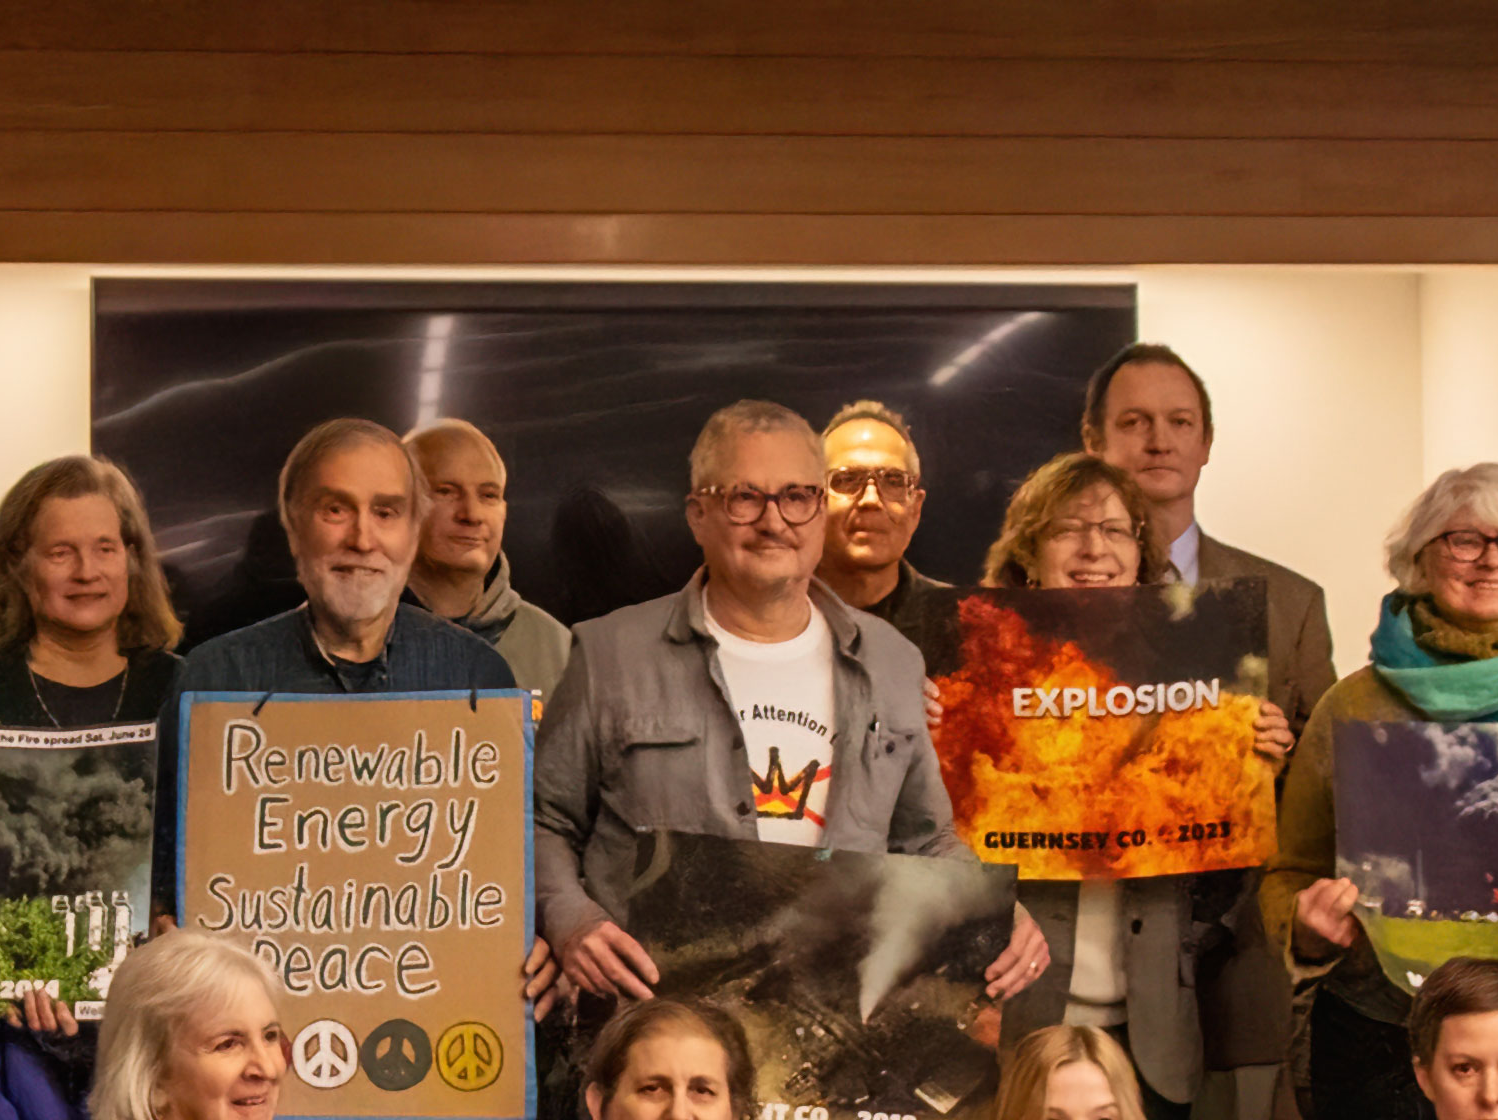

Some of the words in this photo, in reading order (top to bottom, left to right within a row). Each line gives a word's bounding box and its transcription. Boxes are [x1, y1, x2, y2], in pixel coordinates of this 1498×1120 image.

[1012, 678, 1219, 717] EXPLOSION
[109, 730, 135, 742] June
[752, 704, 827, 736] Attention
[222, 718, 500, 795] Renewable
[253, 795, 478, 870] Energy
[984, 831, 1110, 850] GUERNSEY
[1178, 821, 1231, 842] 2023
[198, 865, 505, 932] Sustainable
